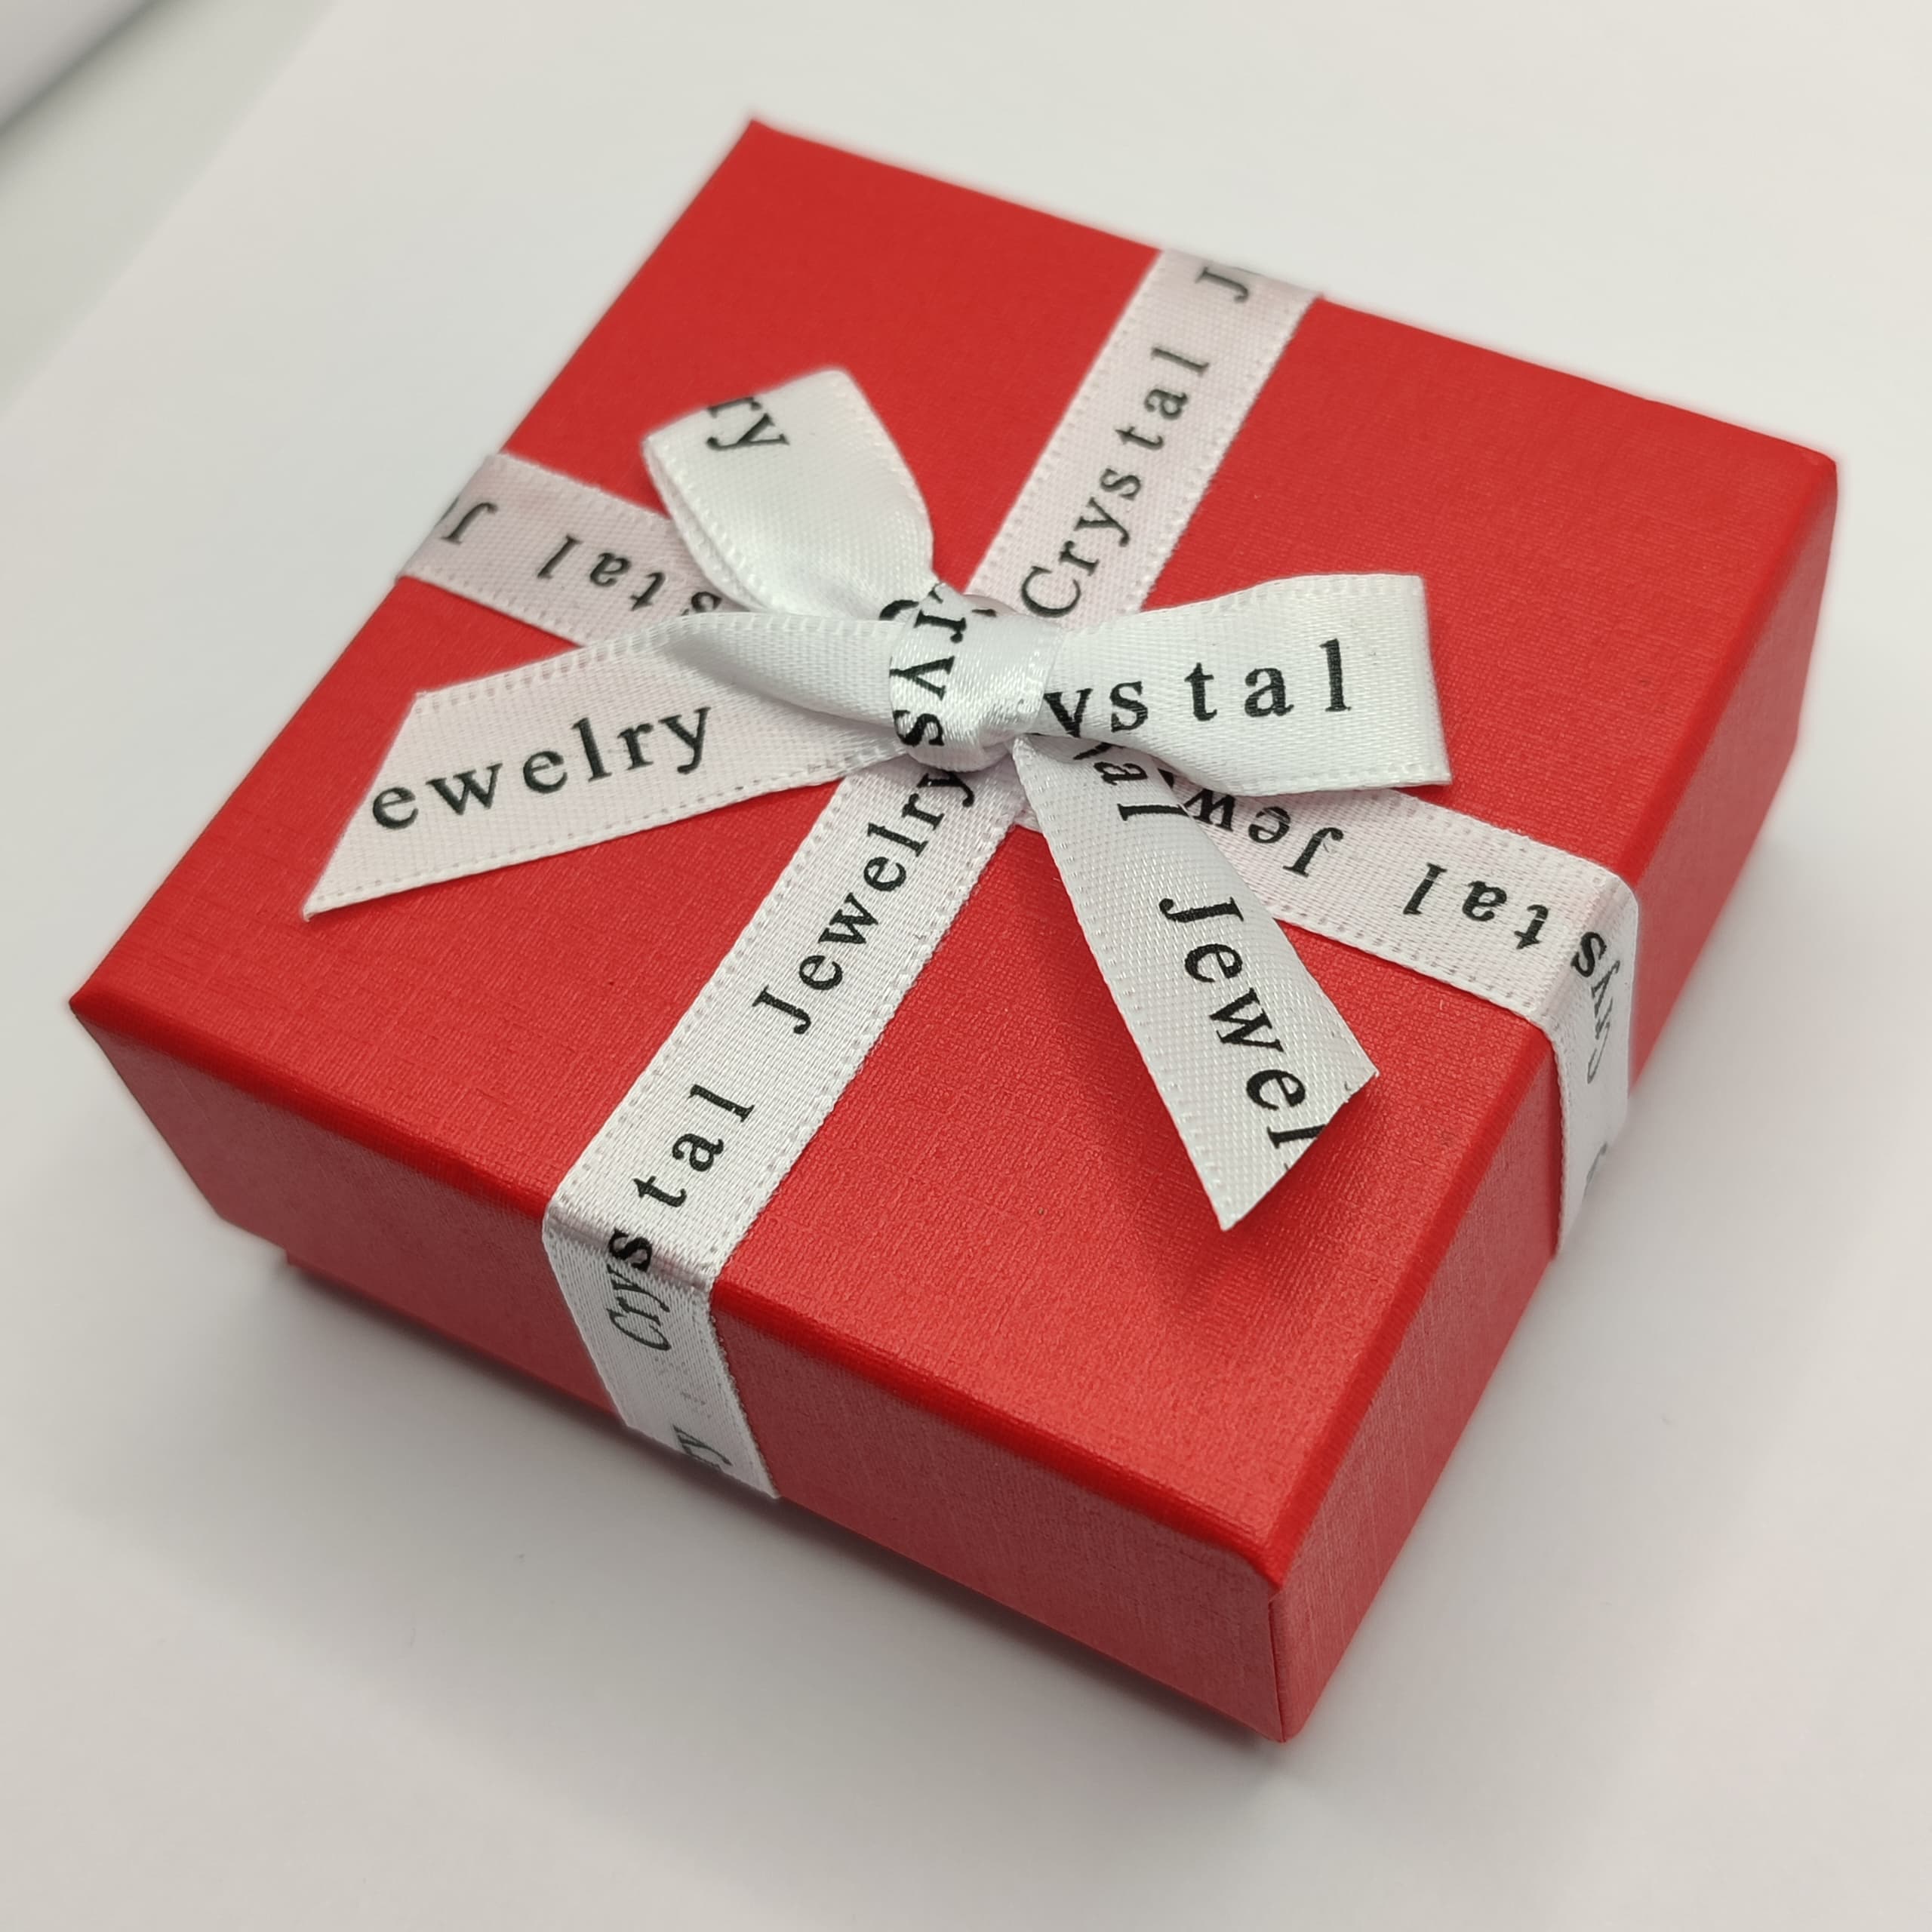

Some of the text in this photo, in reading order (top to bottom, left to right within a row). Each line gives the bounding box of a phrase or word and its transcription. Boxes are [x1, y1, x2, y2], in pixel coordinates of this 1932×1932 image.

[1020, 345, 1209, 618] Crystal
[1195, 266, 1249, 303] J
[371, 706, 711, 829] ewelry
[888, 581, 967, 747] rys
[606, 768, 974, 1351] Crystal Jewelry
[1158, 768, 1620, 1084] Jew Crystal
[1158, 896, 1326, 1149] Jewel
